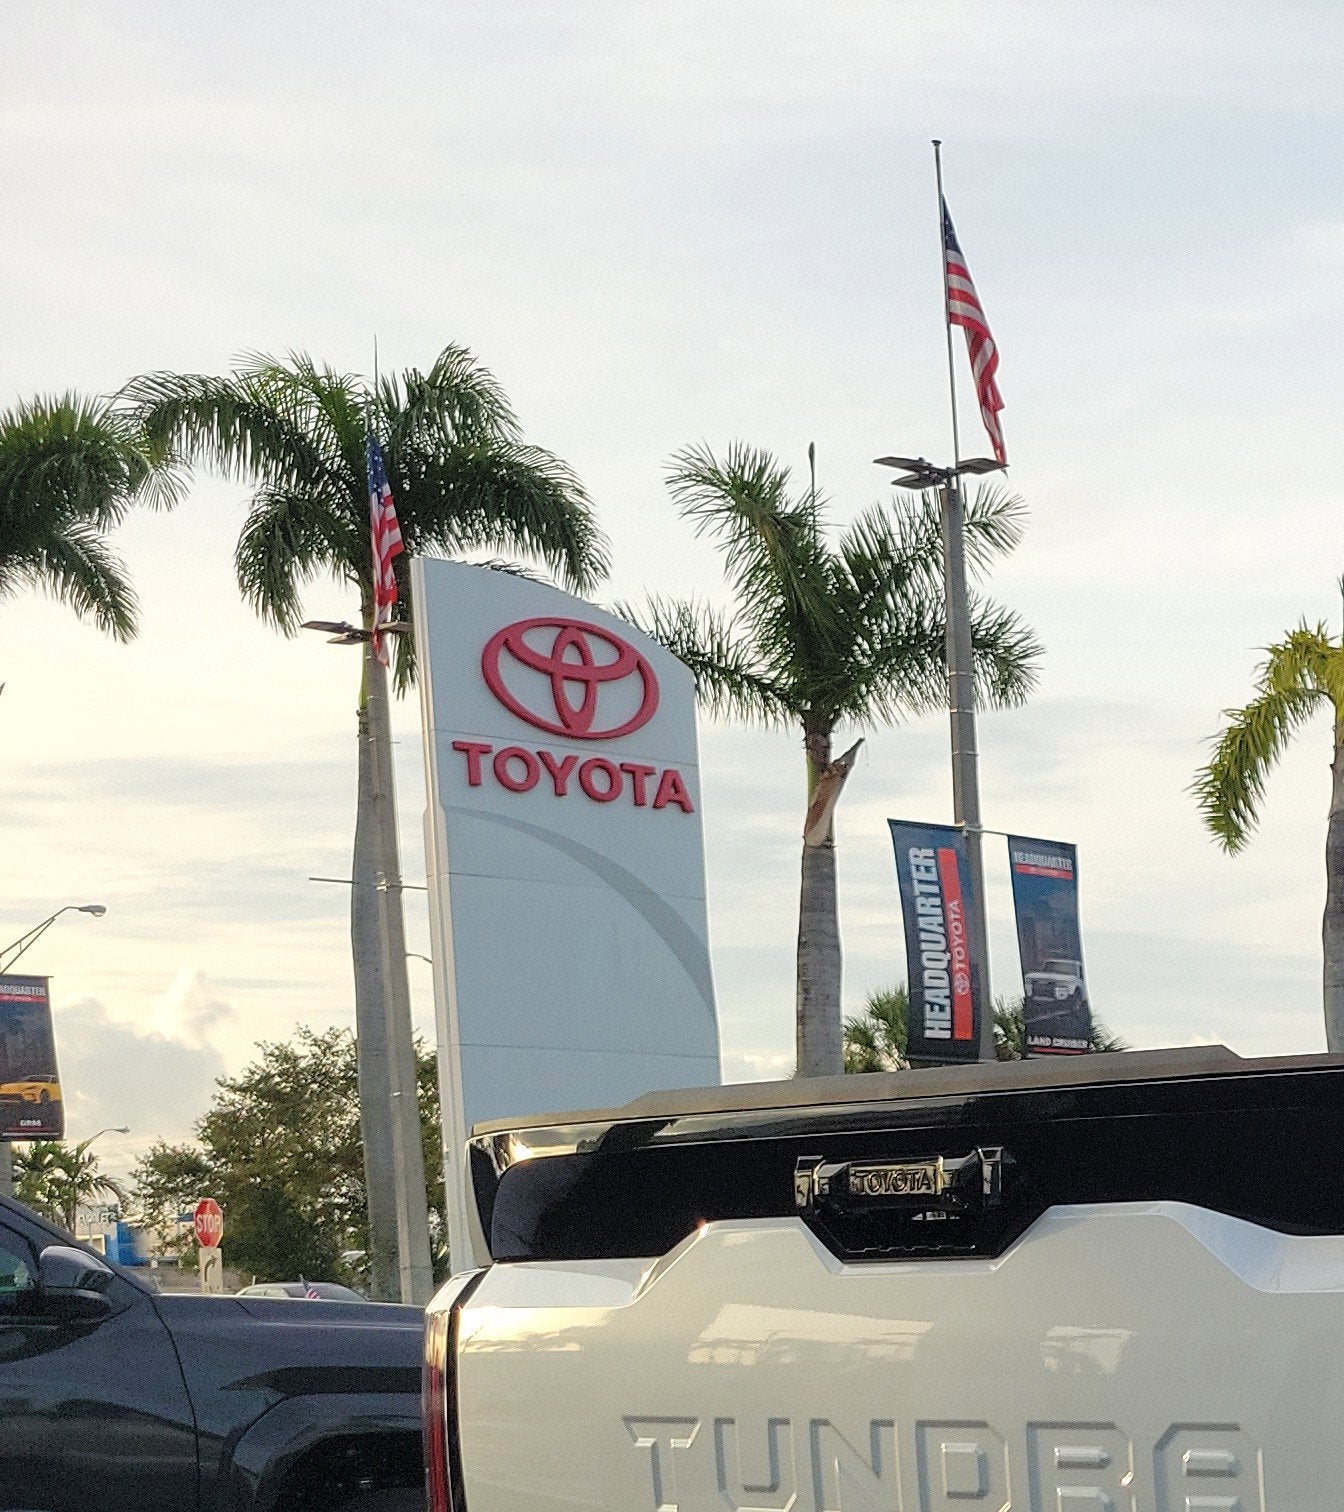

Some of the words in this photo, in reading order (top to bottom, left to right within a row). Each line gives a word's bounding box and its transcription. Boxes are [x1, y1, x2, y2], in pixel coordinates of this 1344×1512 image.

[452, 740, 694, 813] TOYOTA
[909, 847, 952, 1039] HEADQUARTER
[949, 900, 967, 970] TOYOTA
[853, 1167, 932, 1193] TOYOTA
[196, 1213, 222, 1234] STOP
